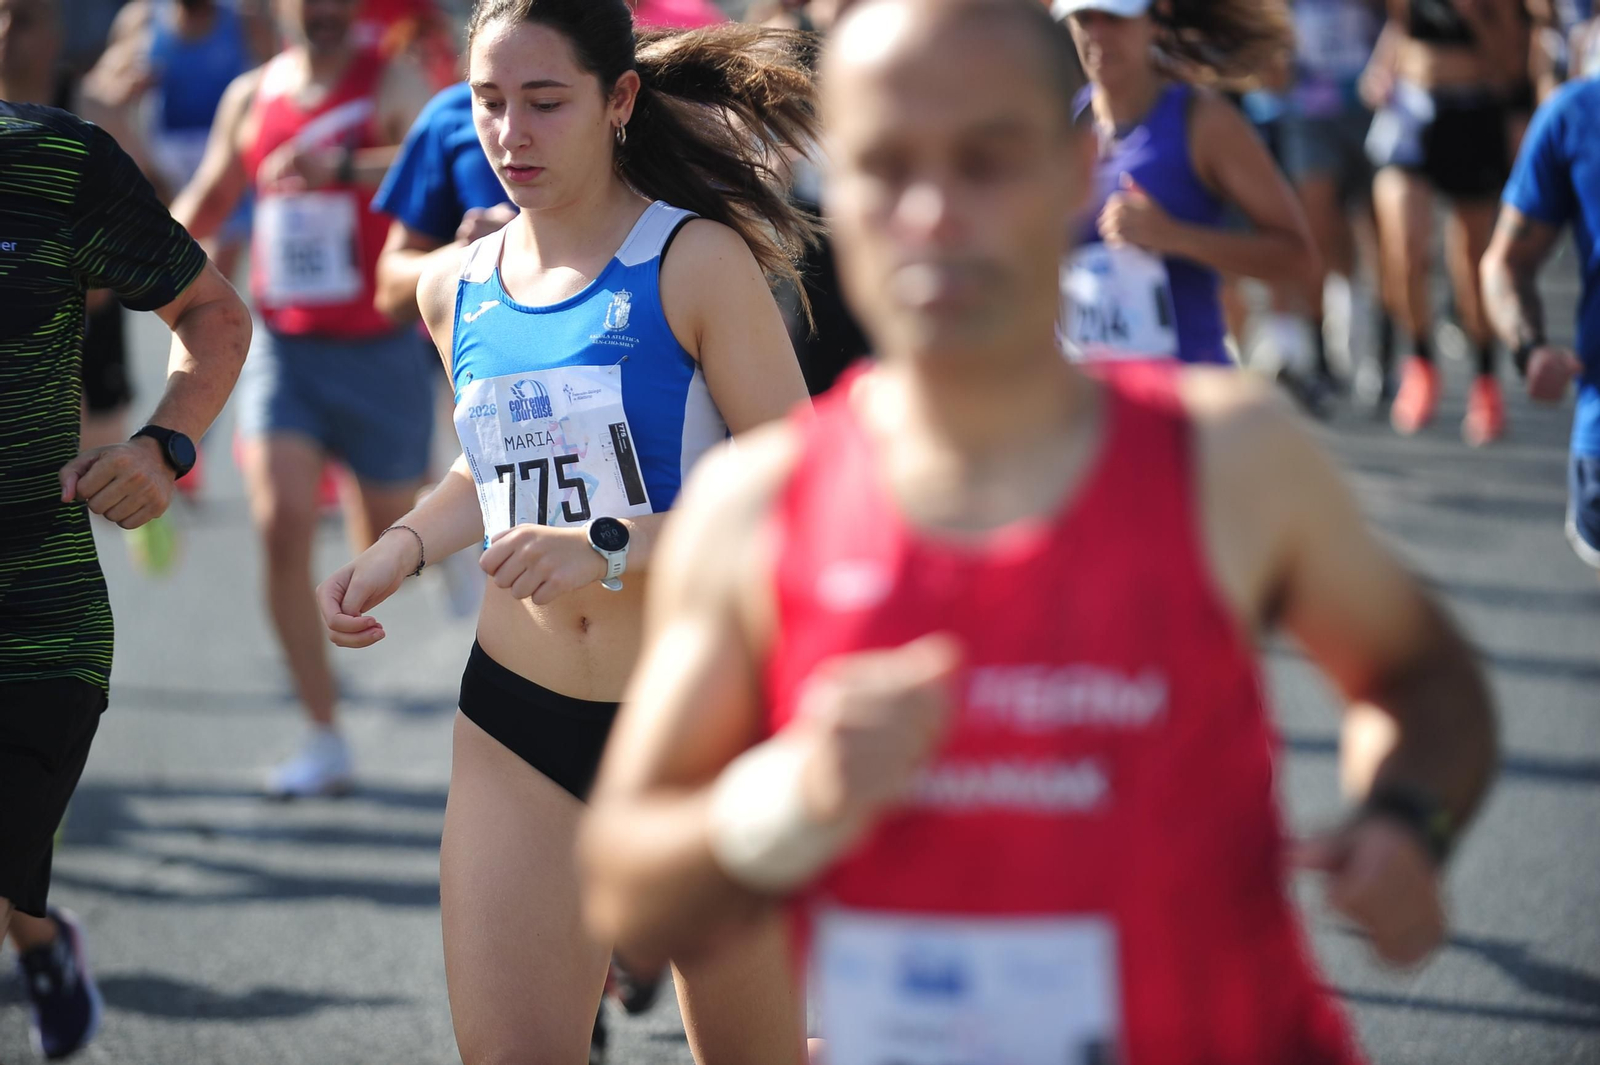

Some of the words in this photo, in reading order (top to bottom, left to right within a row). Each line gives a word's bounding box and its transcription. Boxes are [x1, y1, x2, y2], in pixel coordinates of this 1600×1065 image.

[0, 236, 11, 244] er
[468, 403, 497, 419] 2026
[504, 430, 555, 452] MARIA
[494, 453, 592, 529] 775
